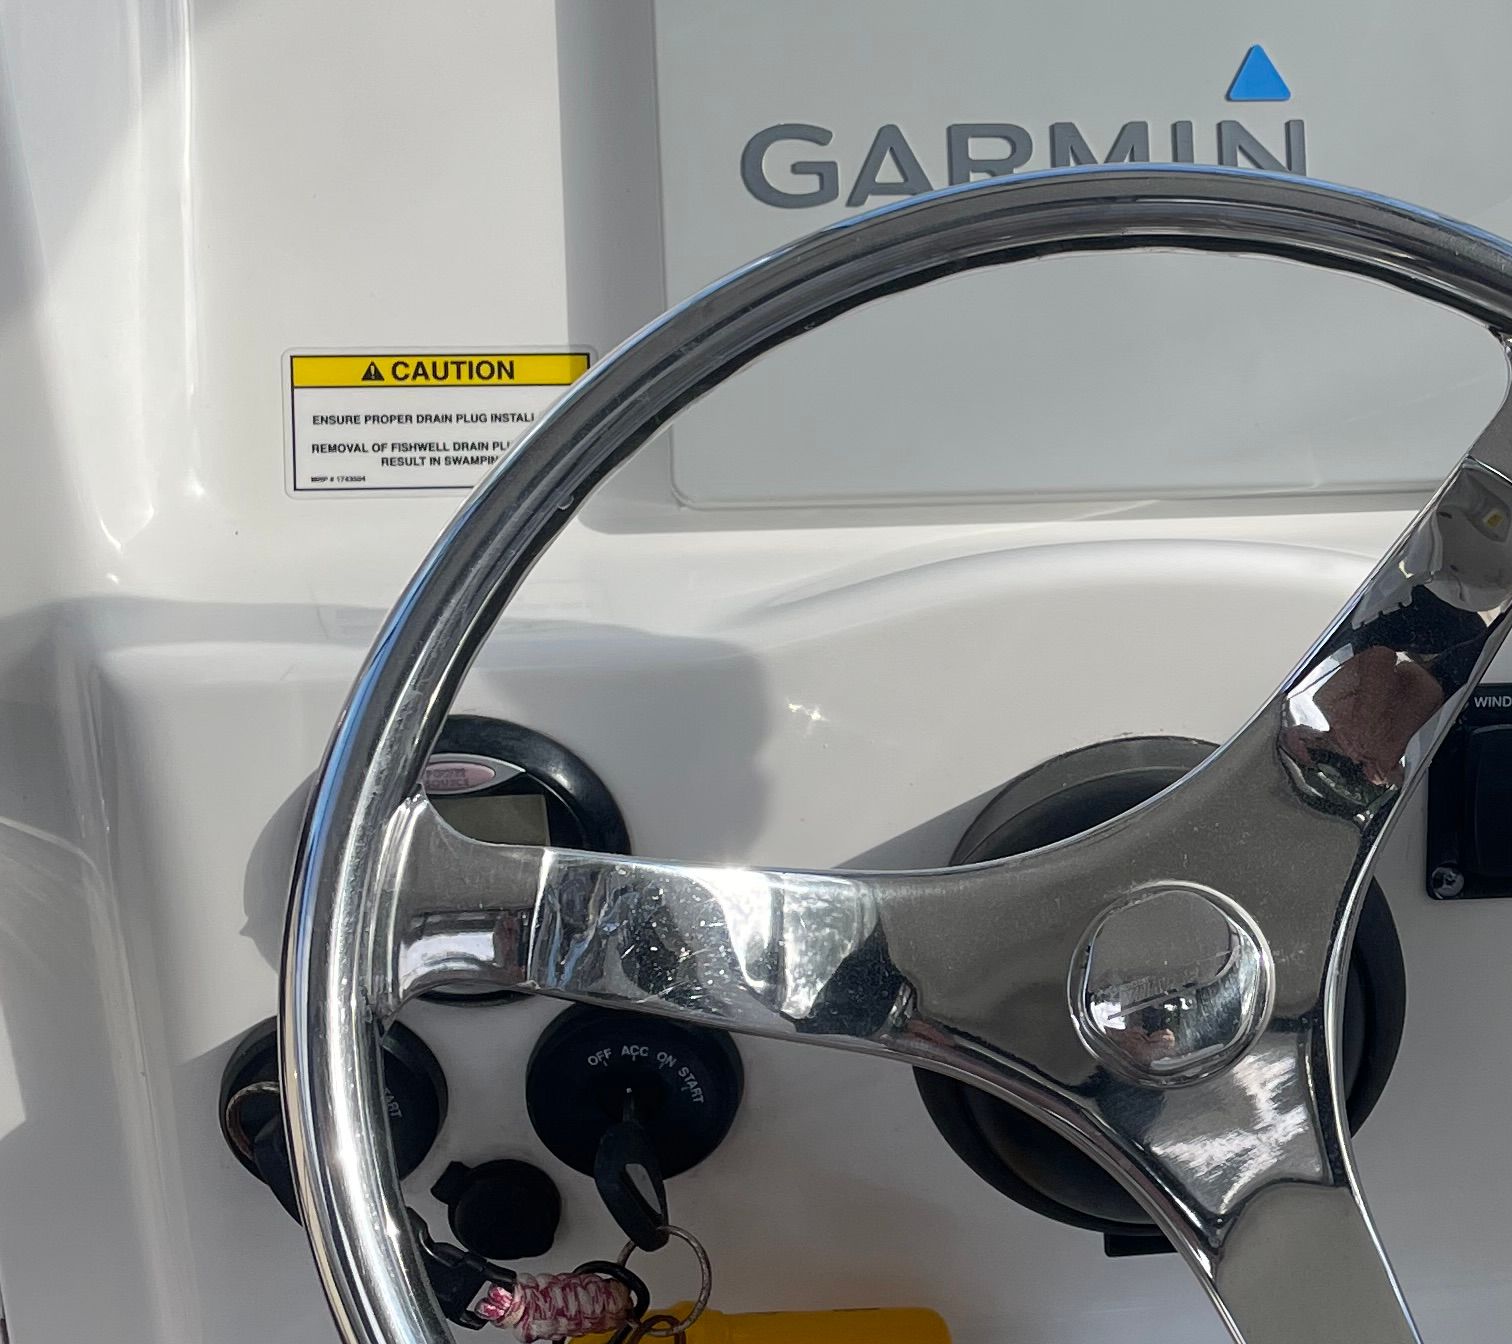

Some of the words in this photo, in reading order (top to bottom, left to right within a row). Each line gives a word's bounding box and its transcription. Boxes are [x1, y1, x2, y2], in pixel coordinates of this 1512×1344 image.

[741, 120, 1306, 208] GARMIN
[391, 360, 515, 381] CAUTION
[313, 415, 361, 425] ENSURE
[365, 414, 413, 424] PROPER
[416, 413, 452, 424] DRAIN
[456, 413, 488, 423] PLUG
[311, 443, 368, 453] REMOVAL
[372, 443, 387, 452] OF
[391, 442, 450, 452] FISHWELL
[453, 442, 489, 451] DRAIN
[381, 457, 426, 466] RESULT
[430, 456, 441, 466] IN
[588, 1048, 612, 1065] OFF
[621, 1045, 649, 1056] ACC
[657, 1052, 677, 1067] ON
[679, 1067, 704, 1103] START
